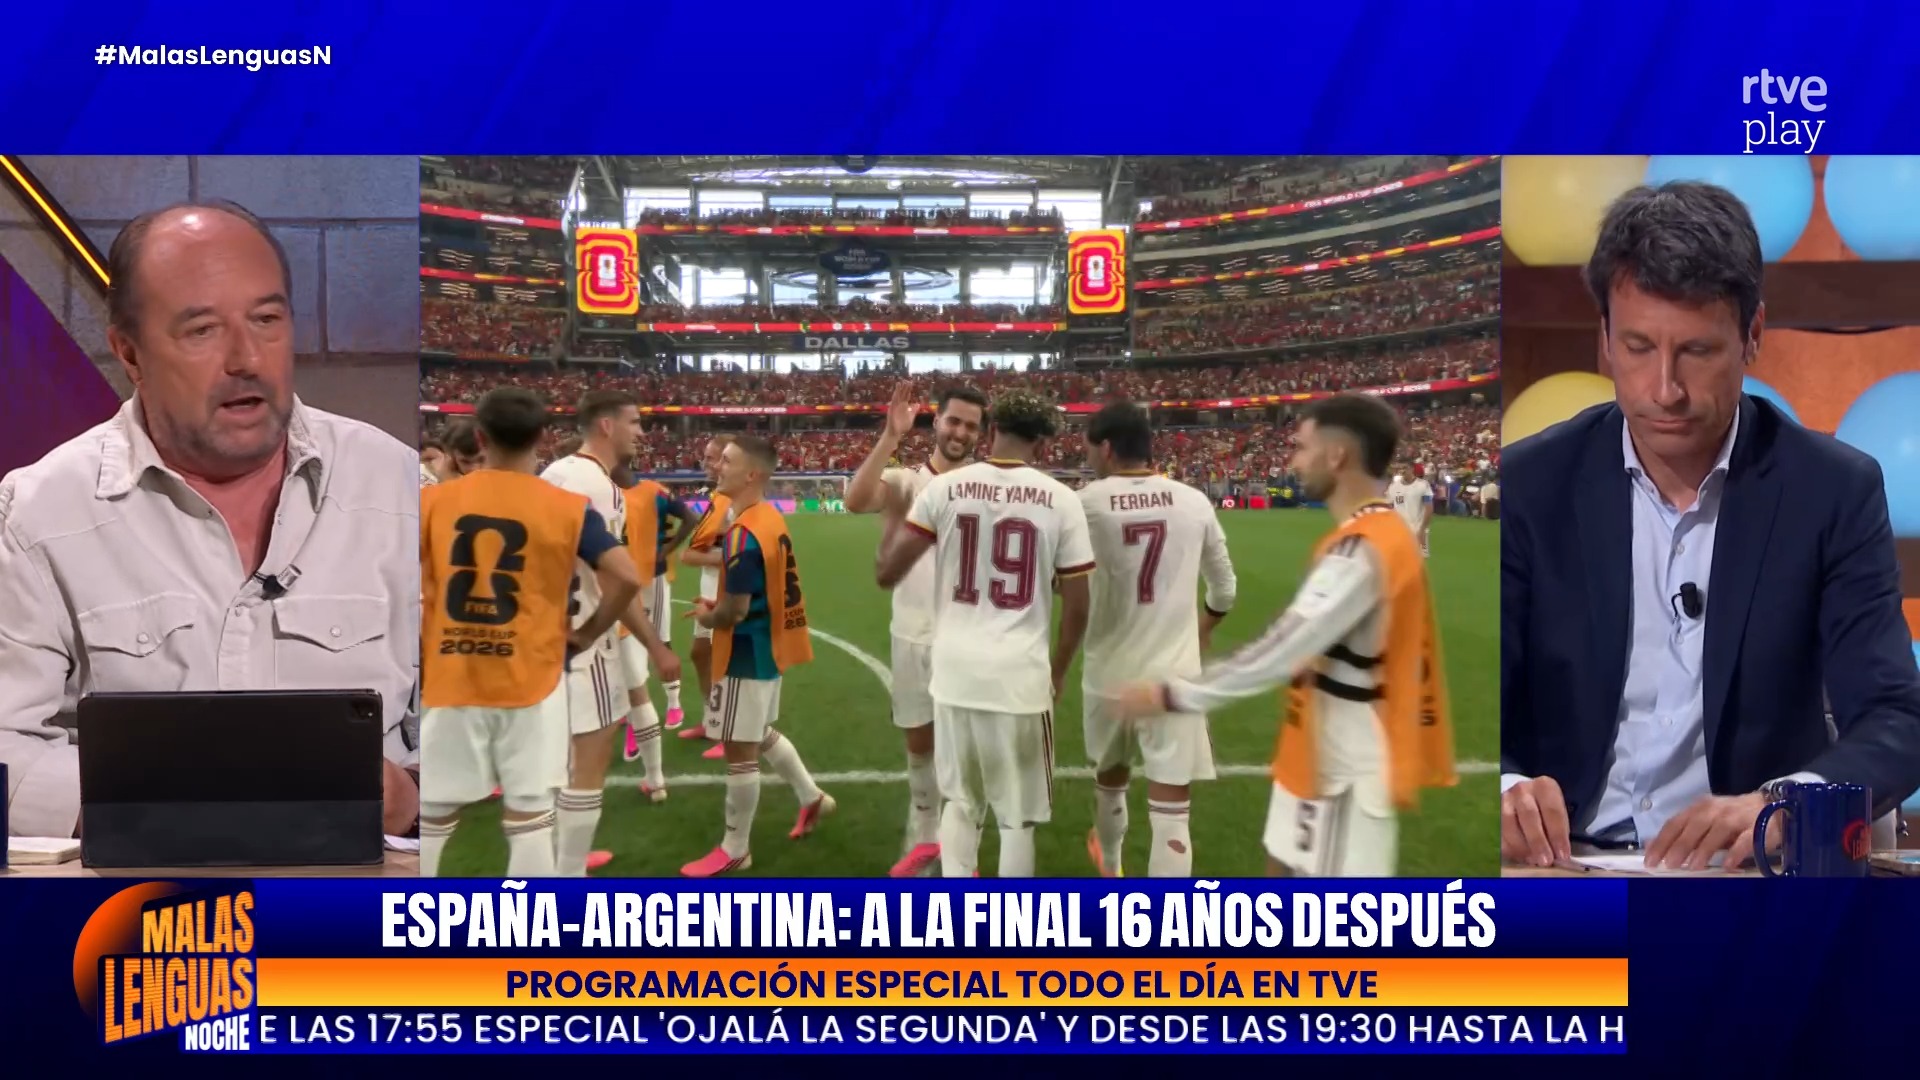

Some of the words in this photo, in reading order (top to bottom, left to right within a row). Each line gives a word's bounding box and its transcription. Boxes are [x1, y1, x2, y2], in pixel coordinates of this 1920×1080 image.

[804, 336, 910, 349] DALLAS
[948, 481, 1002, 502] LAMINE
[1005, 486, 1055, 510] YAMAL
[1110, 491, 1174, 512] FERRAN
[952, 513, 1038, 612] 19
[1122, 519, 1168, 605] 7
[464, 601, 498, 616] FIFA
[443, 627, 486, 638] WORLD
[489, 628, 518, 639] CUP
[440, 639, 514, 657] 2026
